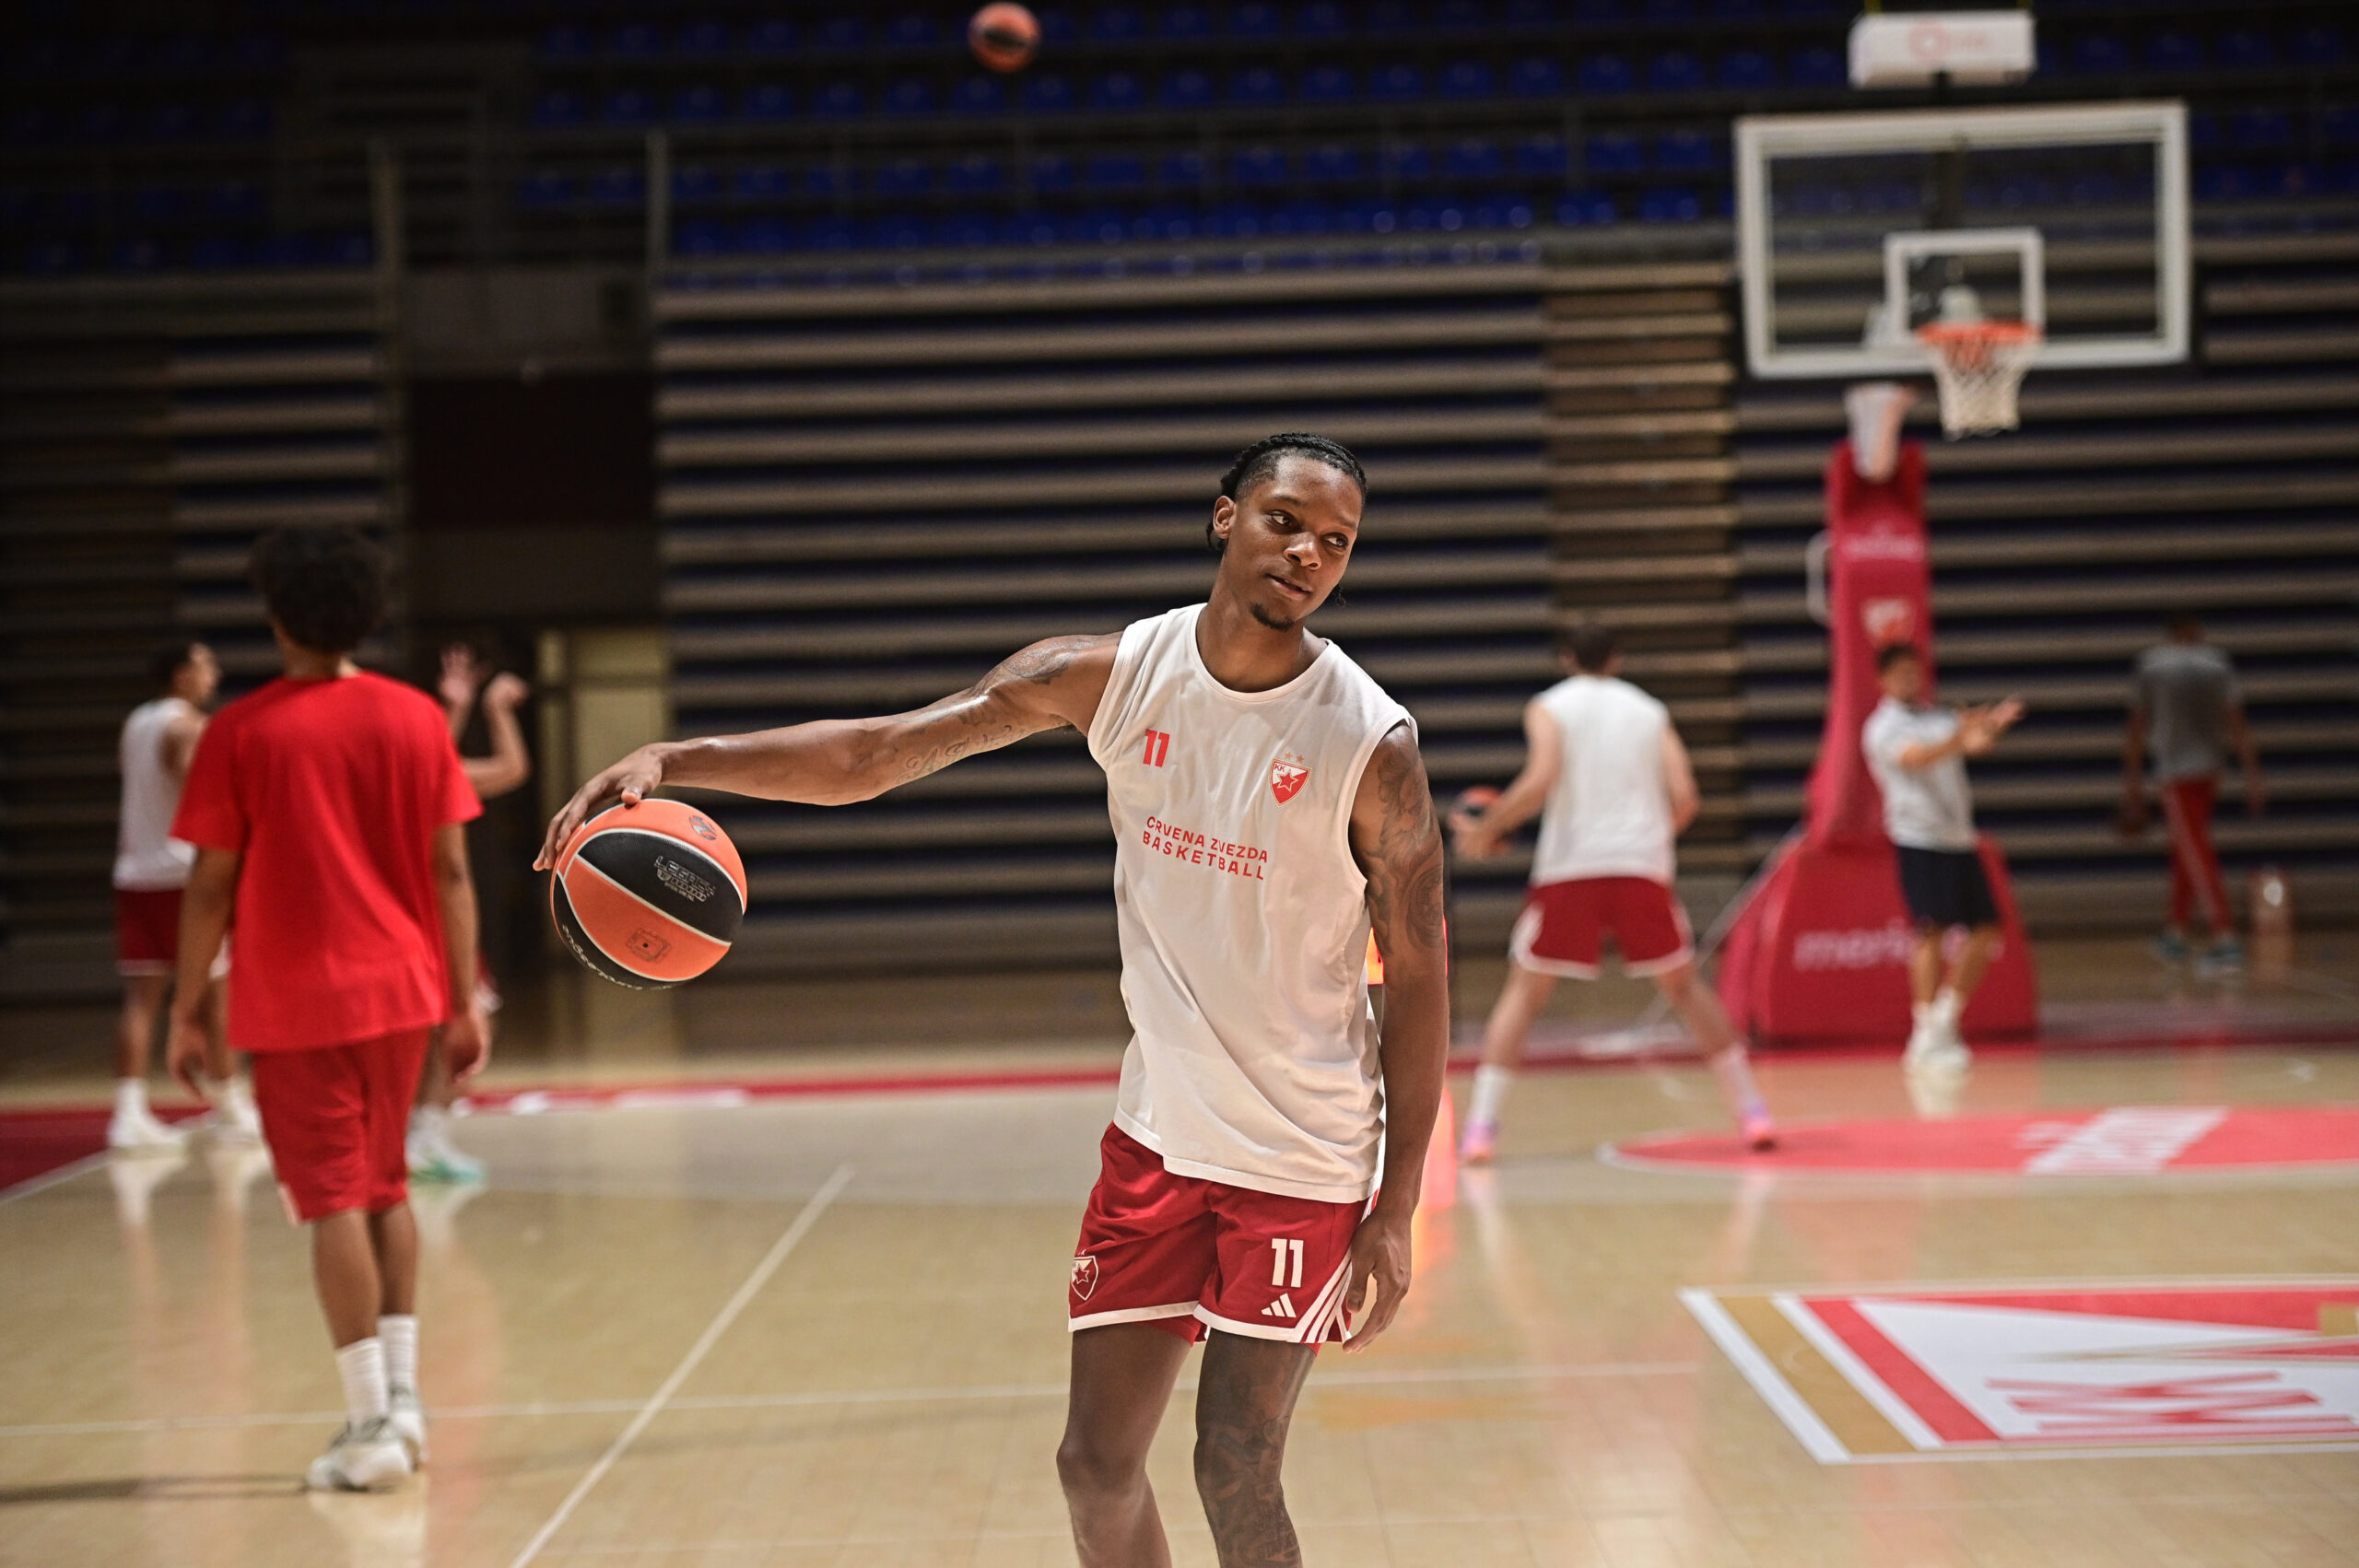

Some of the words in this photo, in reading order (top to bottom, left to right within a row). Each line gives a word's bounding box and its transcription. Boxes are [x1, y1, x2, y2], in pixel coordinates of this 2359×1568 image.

[1143, 729, 1170, 767] 11
[1274, 764, 1285, 772] KK
[1143, 830, 1264, 881] BASKETBALL
[1146, 816, 1205, 847] CRVENA
[1210, 837, 1268, 863] ZVEZDA
[1271, 1237, 1304, 1288] 11
